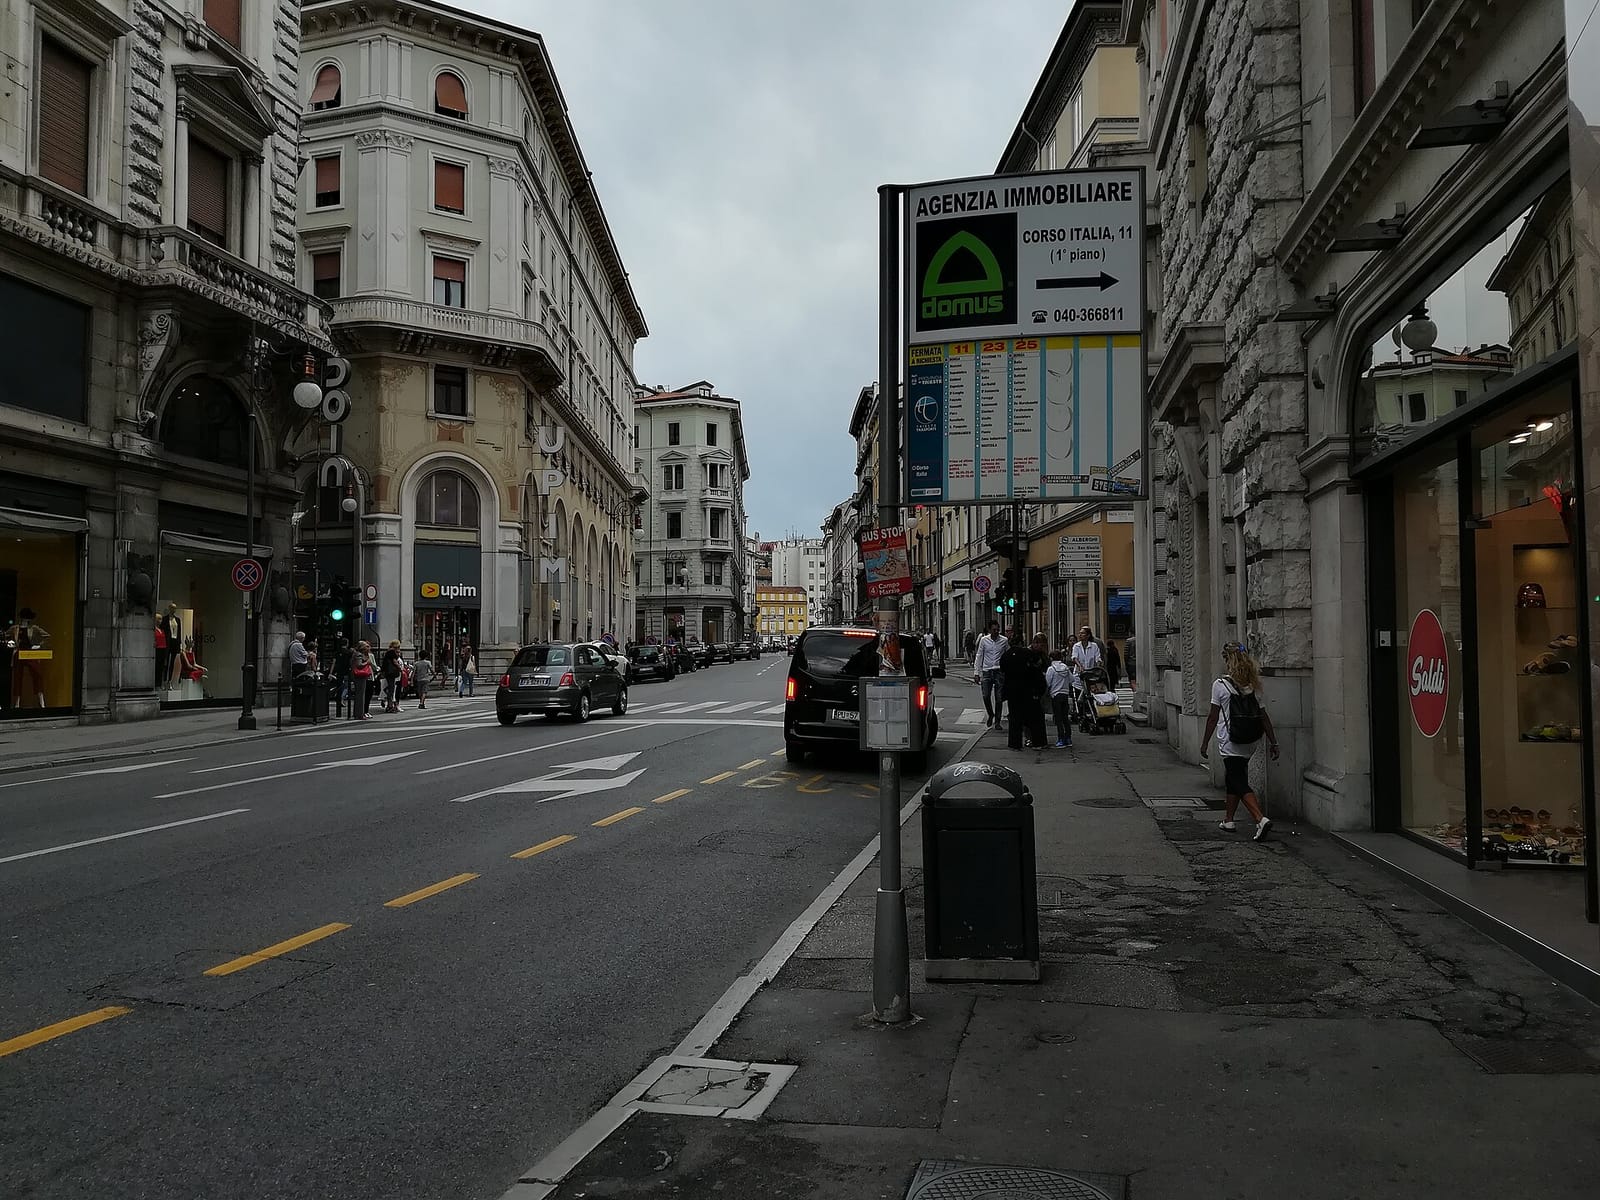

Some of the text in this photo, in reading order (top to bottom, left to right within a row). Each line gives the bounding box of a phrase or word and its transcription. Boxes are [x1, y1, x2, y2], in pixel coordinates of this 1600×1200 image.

[915, 181, 1133, 218] AGENZIA IMMOBILIARE
[1022, 225, 1133, 244] CORSO ITALIA, 11
[1069, 247, 1107, 264] piano)
[921, 294, 1005, 319] domus
[1053, 307, 1124, 323] 040-366811
[911, 347, 942, 358] FERMATA
[954, 344, 970, 354] 11
[983, 342, 1005, 352] 23
[1015, 340, 1038, 350] 25
[916, 356, 942, 364] RICHIESTA
[538, 426, 567, 583] UPIM
[861, 526, 904, 542] BUS STOP
[440, 583, 477, 600] upim
[878, 588, 900, 596] Marzio
[1411, 655, 1445, 696] Saldi
